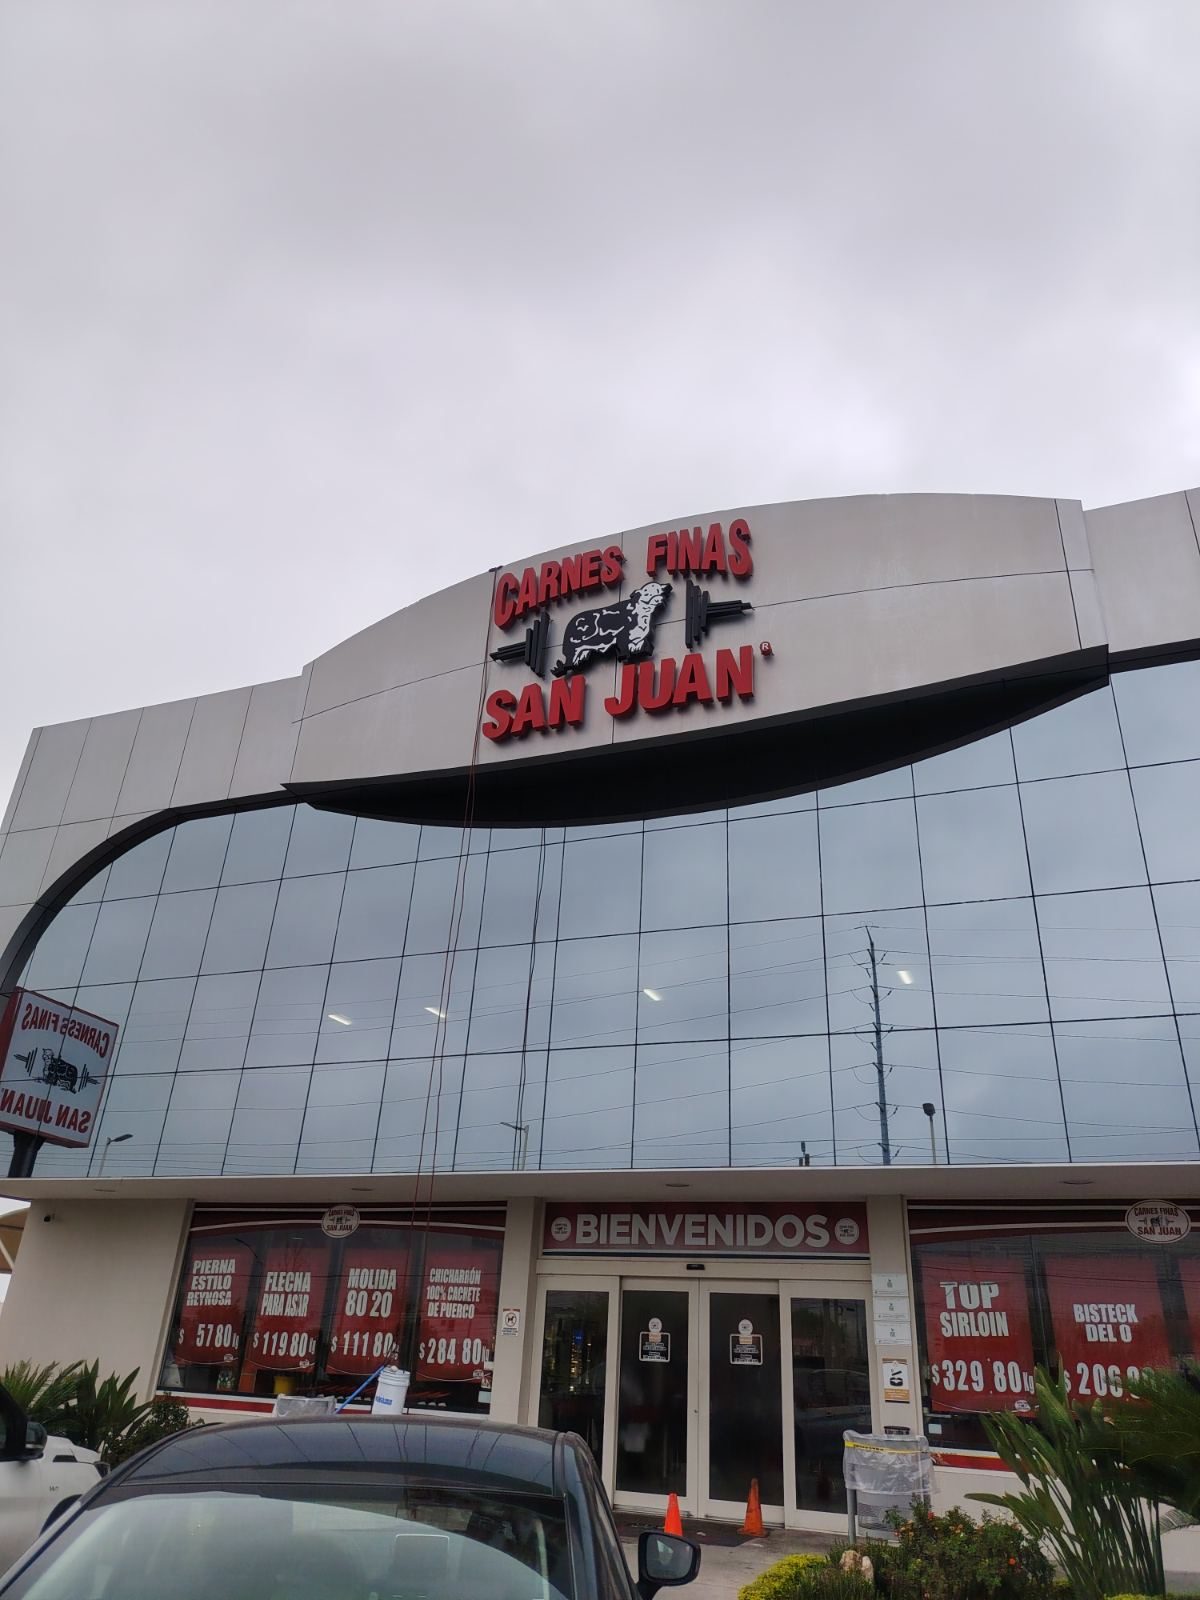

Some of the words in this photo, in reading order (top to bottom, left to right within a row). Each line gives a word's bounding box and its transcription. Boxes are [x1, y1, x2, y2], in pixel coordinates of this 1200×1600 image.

[494, 546, 625, 629] CARNES
[646, 518, 753, 577] FINAS
[482, 673, 587, 743] SAN
[604, 645, 754, 717] JUAN
[1134, 1207, 1158, 1217] CARNES
[575, 1213, 830, 1248] BIENVENIDOS
[1138, 1227, 1155, 1235] SAN
[1158, 1227, 1182, 1236] JUAN
[192, 1259, 236, 1274] PIERNA
[191, 1275, 232, 1290] ESTILO
[347, 1268, 397, 1290] MOLIDA
[186, 1291, 232, 1306] REYNOSA
[260, 1293, 285, 1316] PARA
[284, 1293, 309, 1317] ASAR
[345, 1290, 368, 1317] 80
[369, 1291, 393, 1318] 20
[939, 1281, 999, 1309] TOP
[427, 1302, 440, 1317] DE
[440, 1303, 475, 1319] PUERCO
[1073, 1303, 1139, 1323] BISTECK
[940, 1312, 1009, 1337] SIRLOIN
[1085, 1324, 1118, 1342] DEL
